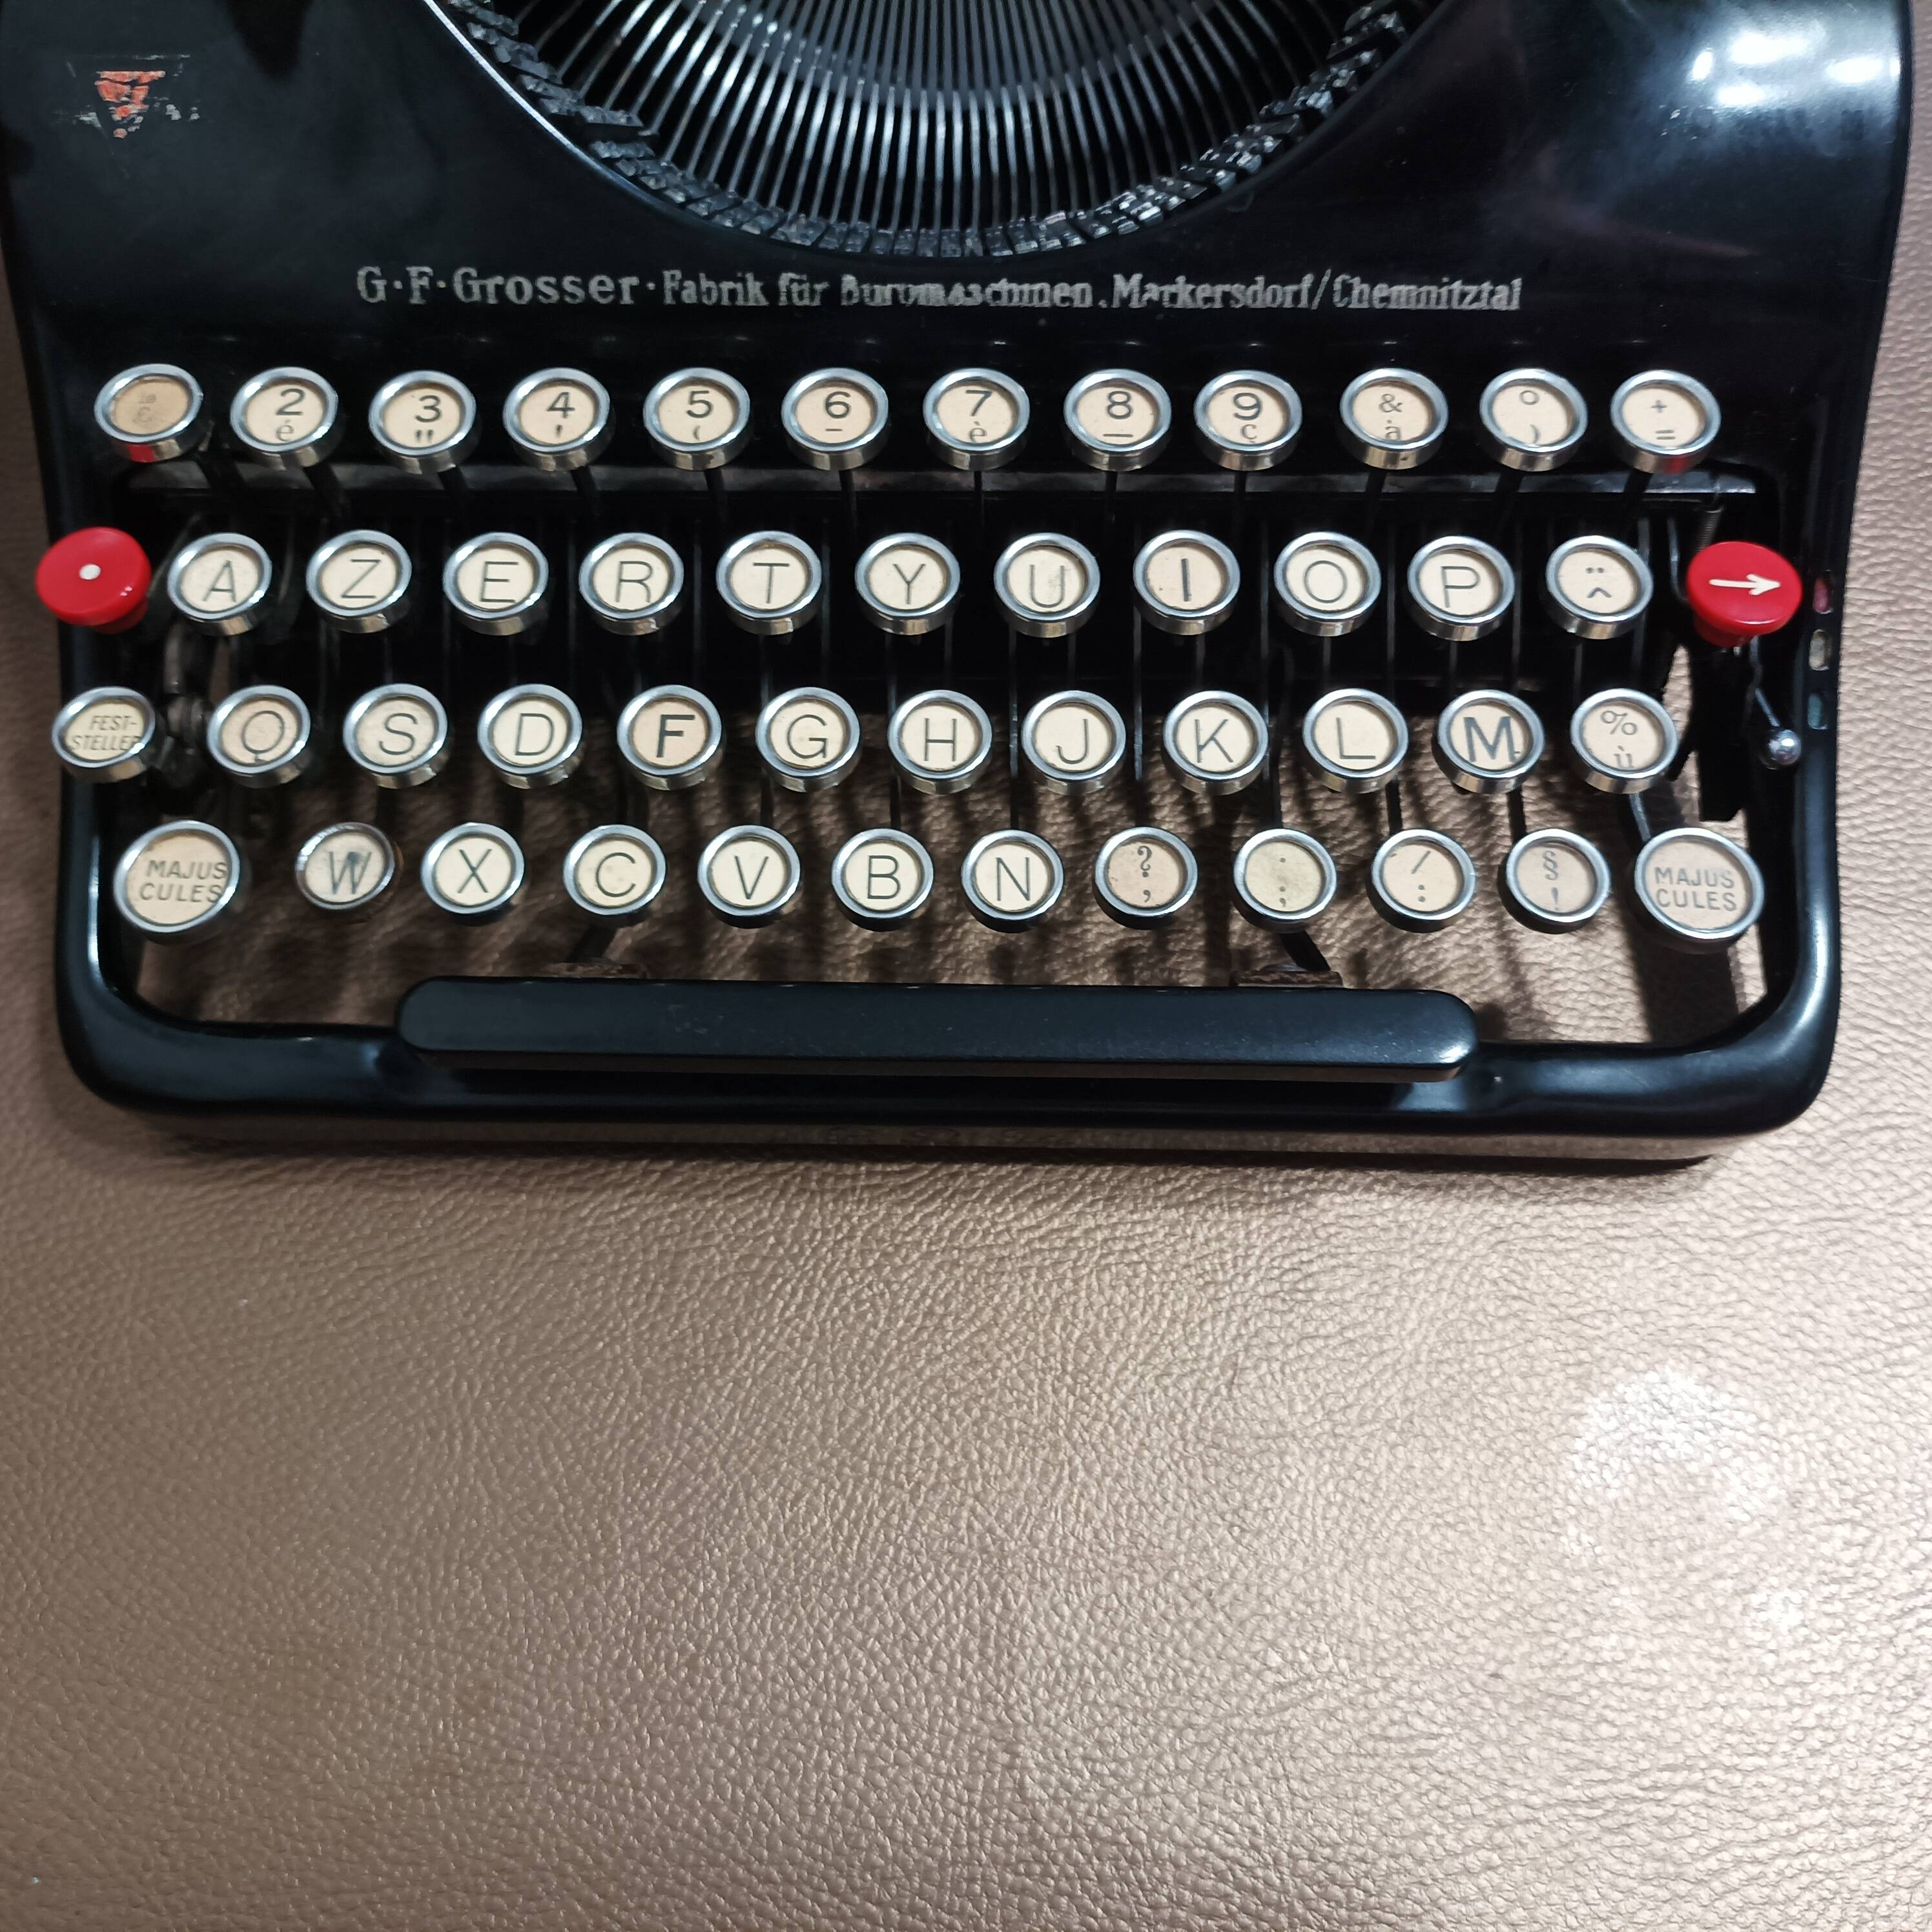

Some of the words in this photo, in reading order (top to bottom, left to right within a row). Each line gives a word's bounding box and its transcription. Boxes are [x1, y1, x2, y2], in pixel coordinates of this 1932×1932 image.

[274, 388, 304, 416] 2
[416, 395, 442, 423] 3
[547, 391, 575, 419] 4
[685, 389, 714, 419] 5
[824, 391, 853, 419] 6
[965, 389, 994, 417] 7
[1105, 391, 1133, 420] 8
[1232, 393, 1262, 421] 9
[1378, 393, 1403, 413] &
[1650, 399, 1668, 414] +
[1654, 428, 1677, 441] =
[202, 559, 237, 602] A
[340, 558, 382, 600] Z
[480, 560, 520, 602] E
[614, 560, 654, 604] R
[752, 561, 791, 604] T
[892, 562, 928, 605] Y
[1029, 564, 1067, 609] U
[1180, 557, 1193, 602] I
[1302, 559, 1349, 605] O
[1439, 565, 1481, 608] P
[378, 712, 419, 756] S
[515, 712, 556, 757] D
[655, 714, 695, 759] F
[786, 714, 828, 760] G
[924, 717, 958, 763] H
[1055, 718, 1089, 765] J
[1194, 719, 1234, 764] K
[1335, 716, 1376, 760] L
[1463, 715, 1514, 764] M
[1599, 710, 1638, 737] %
[145, 859, 228, 881] MAJUS
[327, 850, 373, 896] W
[457, 848, 493, 894] X
[595, 852, 637, 898] C
[733, 855, 769, 901] V
[866, 854, 902, 899] B
[995, 857, 1031, 902] N
[1136, 845, 1153, 879] ?
[1541, 850, 1559, 881] §
[1653, 865, 1736, 888] MAJUS
[139, 882, 223, 903] CULES
[1656, 889, 1738, 912] CULES
